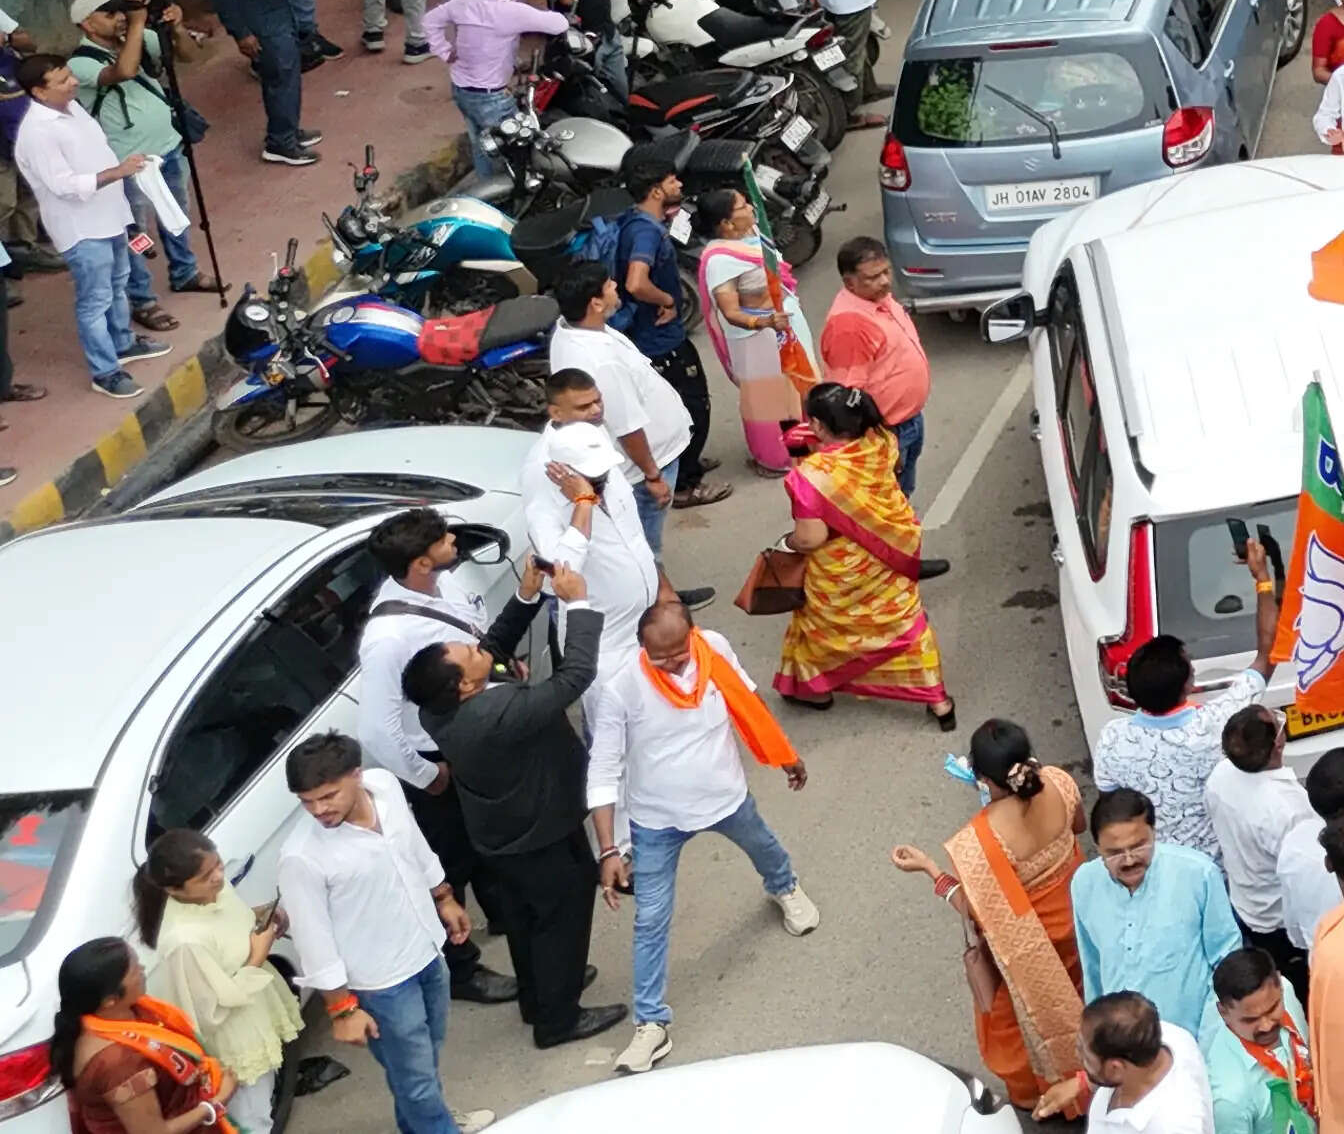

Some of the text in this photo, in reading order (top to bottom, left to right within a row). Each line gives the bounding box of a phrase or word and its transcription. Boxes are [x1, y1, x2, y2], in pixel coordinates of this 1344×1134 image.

[991, 184, 1090, 206] JH 01AV 2804
